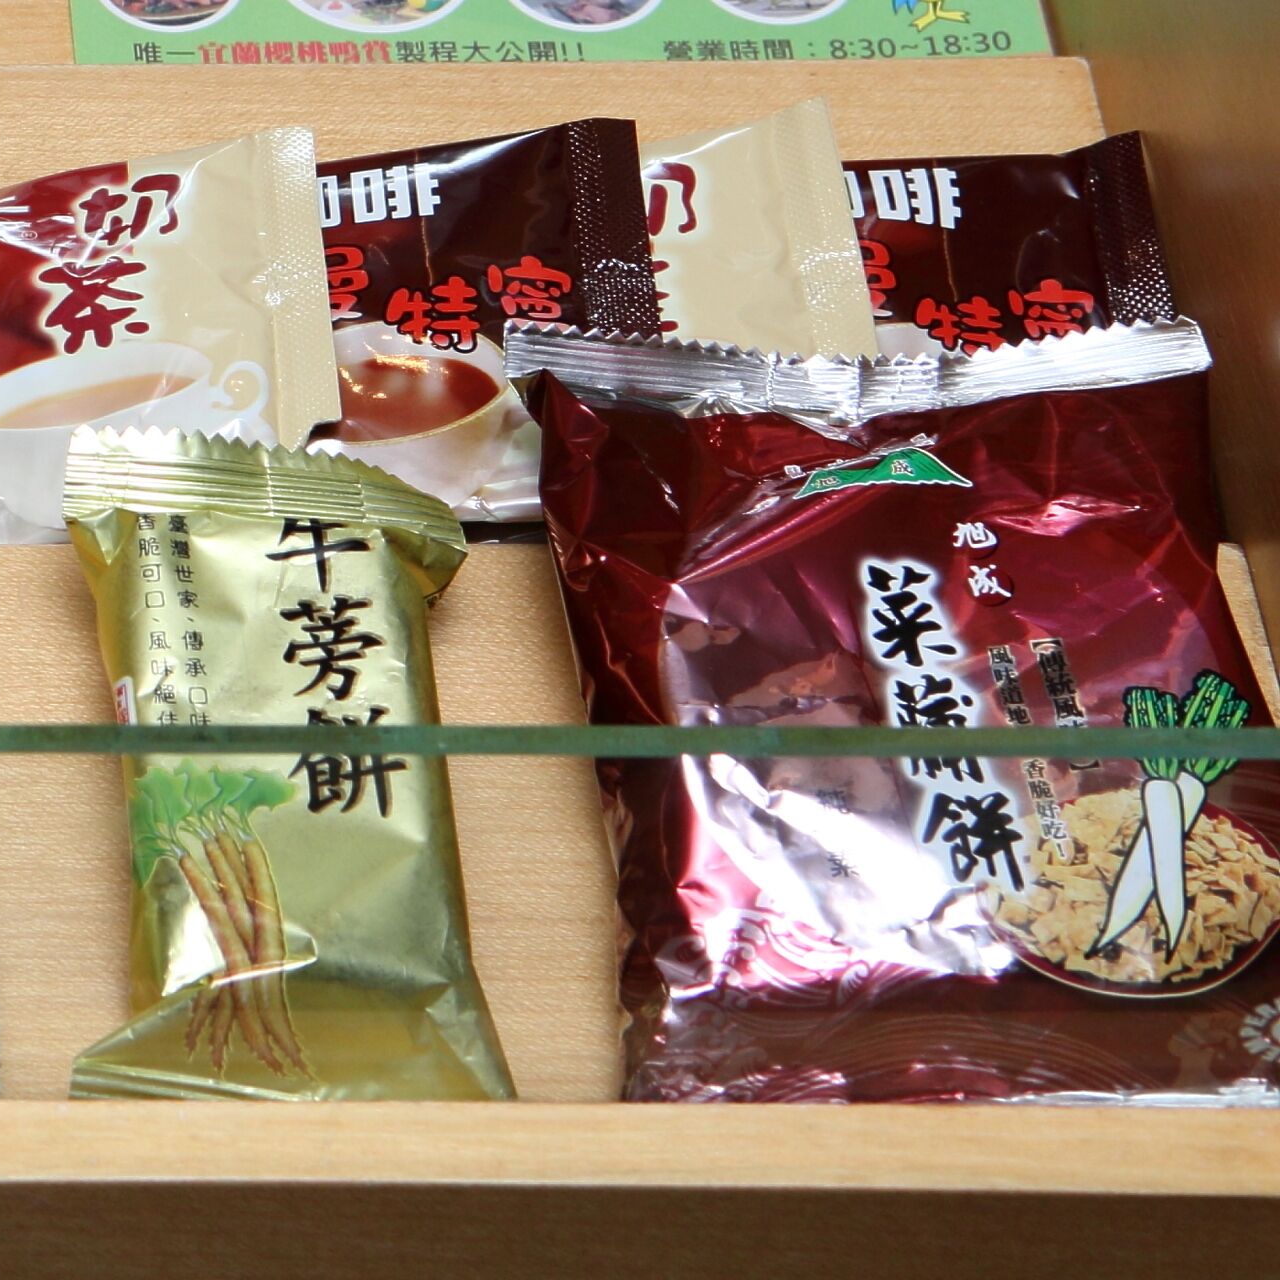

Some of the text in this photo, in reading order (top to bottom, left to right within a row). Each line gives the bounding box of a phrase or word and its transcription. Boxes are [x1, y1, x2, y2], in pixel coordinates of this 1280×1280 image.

[37, 172, 182, 356] 奶茶
[264, 516, 411, 819] 牛蒡餅
